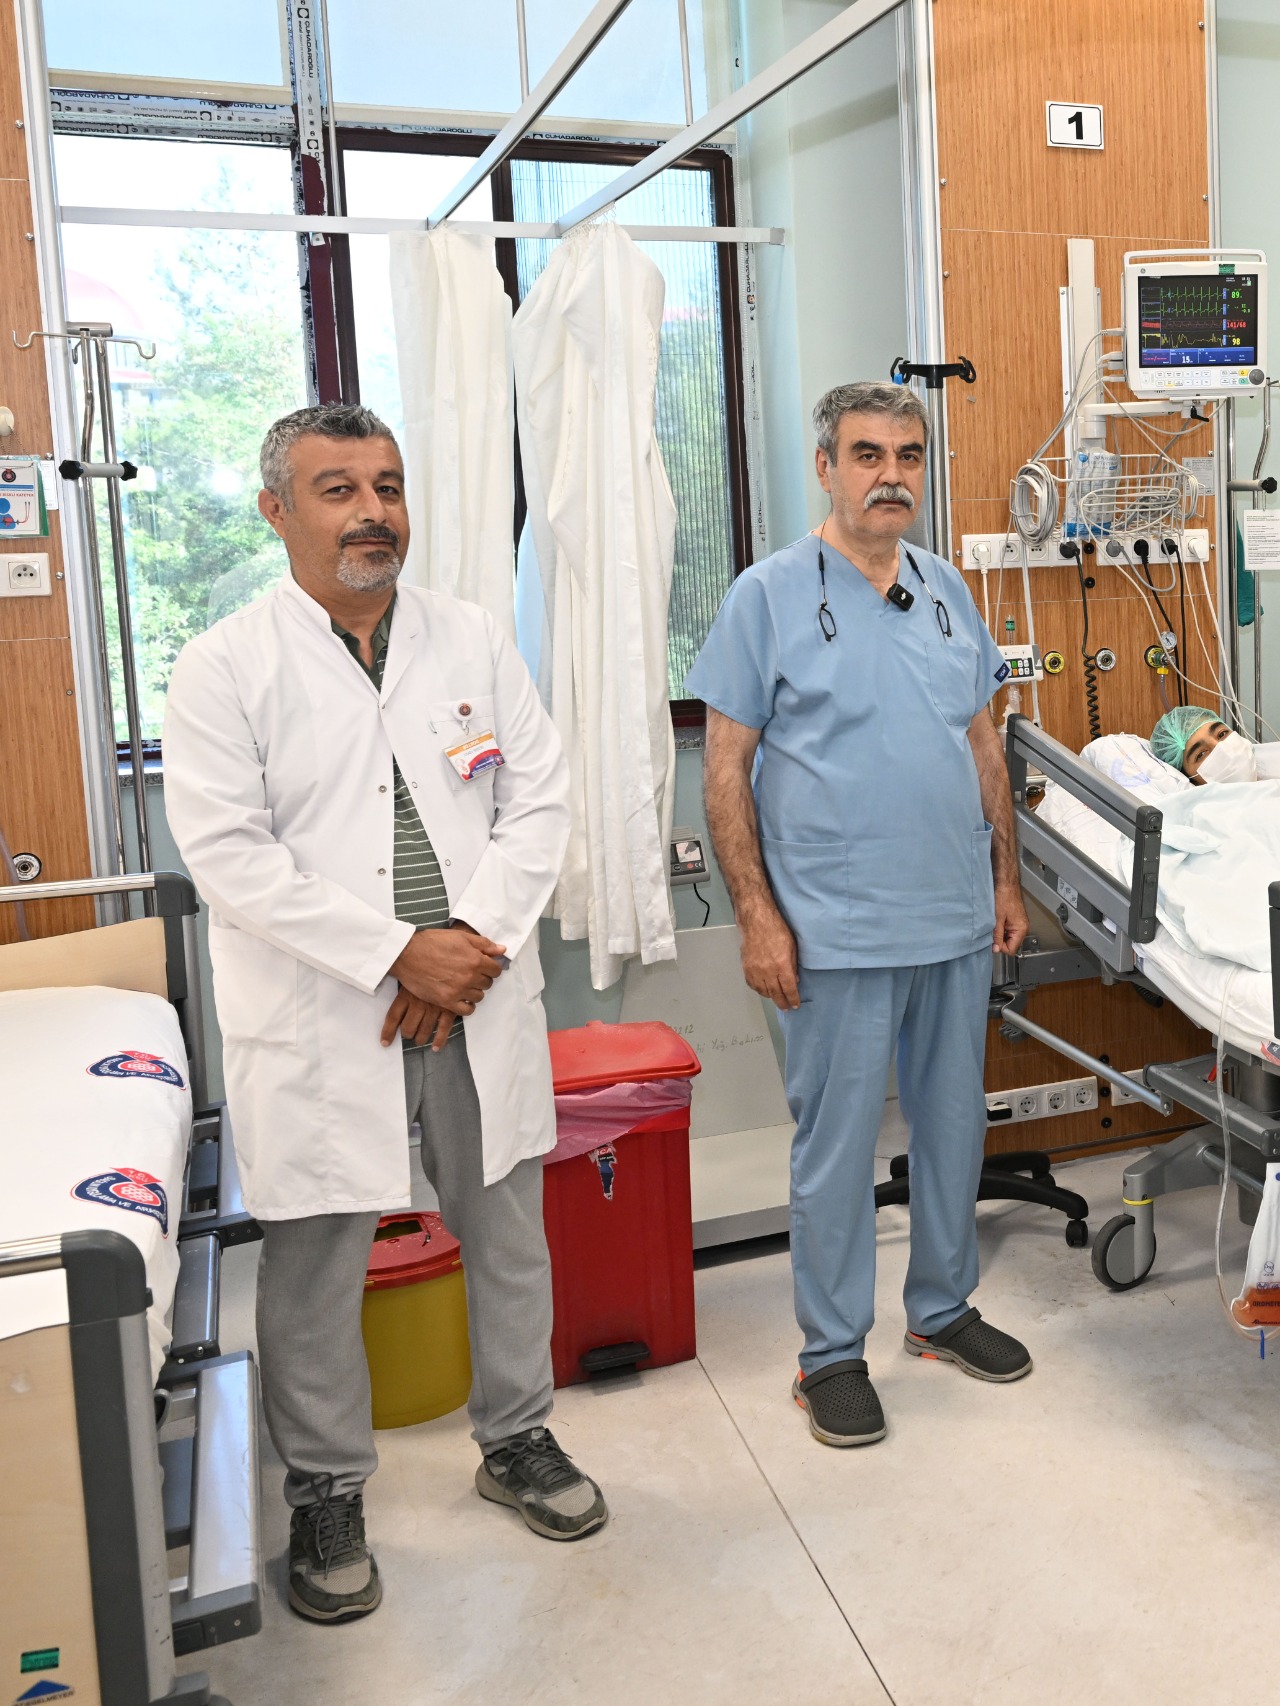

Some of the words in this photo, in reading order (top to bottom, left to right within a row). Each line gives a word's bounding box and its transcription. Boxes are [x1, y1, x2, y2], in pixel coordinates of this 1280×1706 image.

[1068, 111, 1084, 140] 1
[1231, 291, 1240, 299] 89
[1232, 337, 1241, 346] 98
